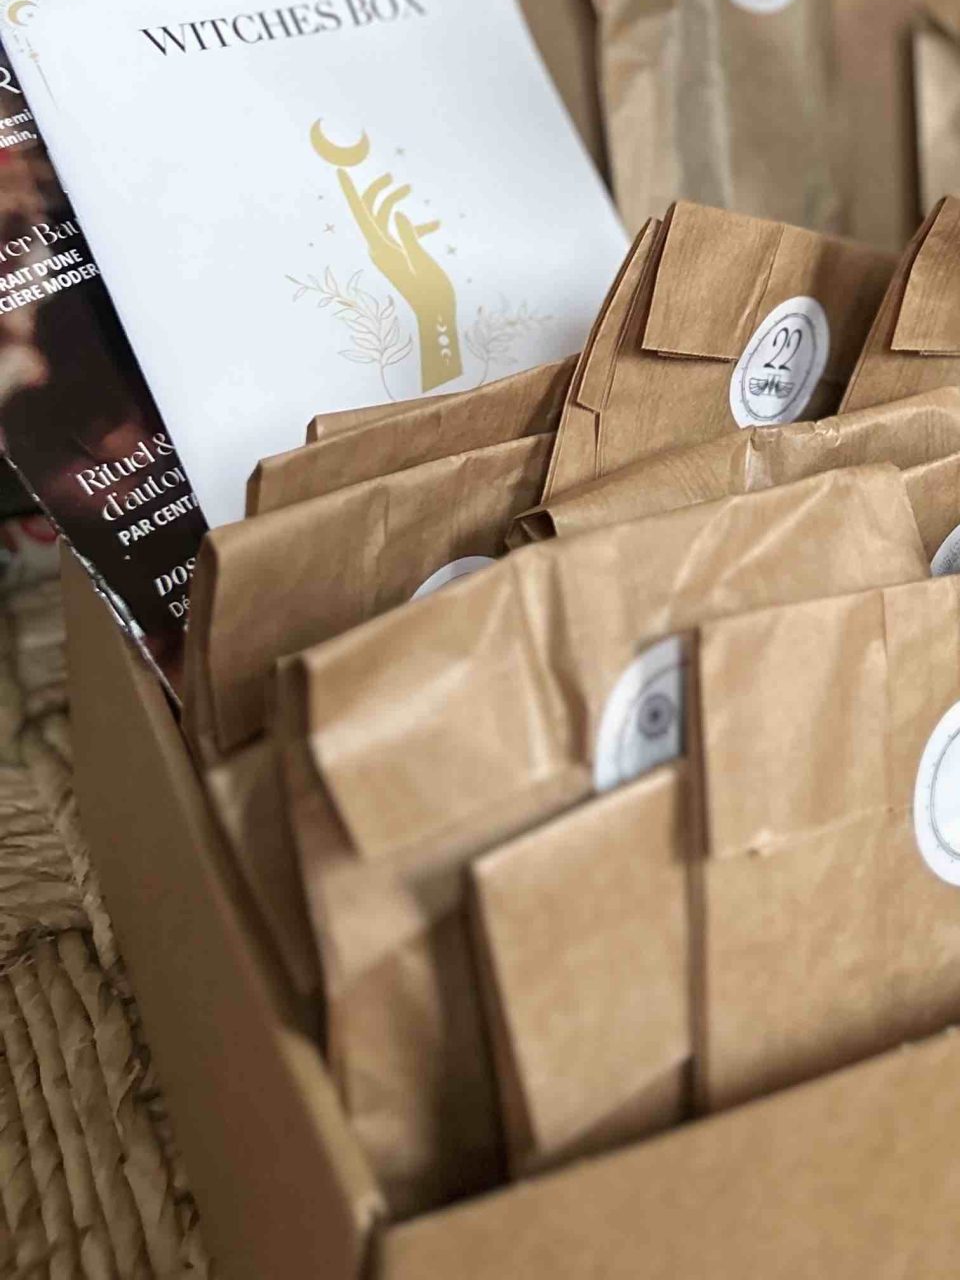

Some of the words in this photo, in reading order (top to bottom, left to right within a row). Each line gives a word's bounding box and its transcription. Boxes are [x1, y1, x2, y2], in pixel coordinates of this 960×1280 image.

[139, 0, 343, 56] WITCHES
[33, 248, 83, 277] D'UNE
[0, 284, 45, 315] CIÈRE
[763, 327, 802, 372] 22
[76, 441, 155, 496] Rituel
[153, 432, 175, 456] &
[118, 519, 156, 546] PAR
